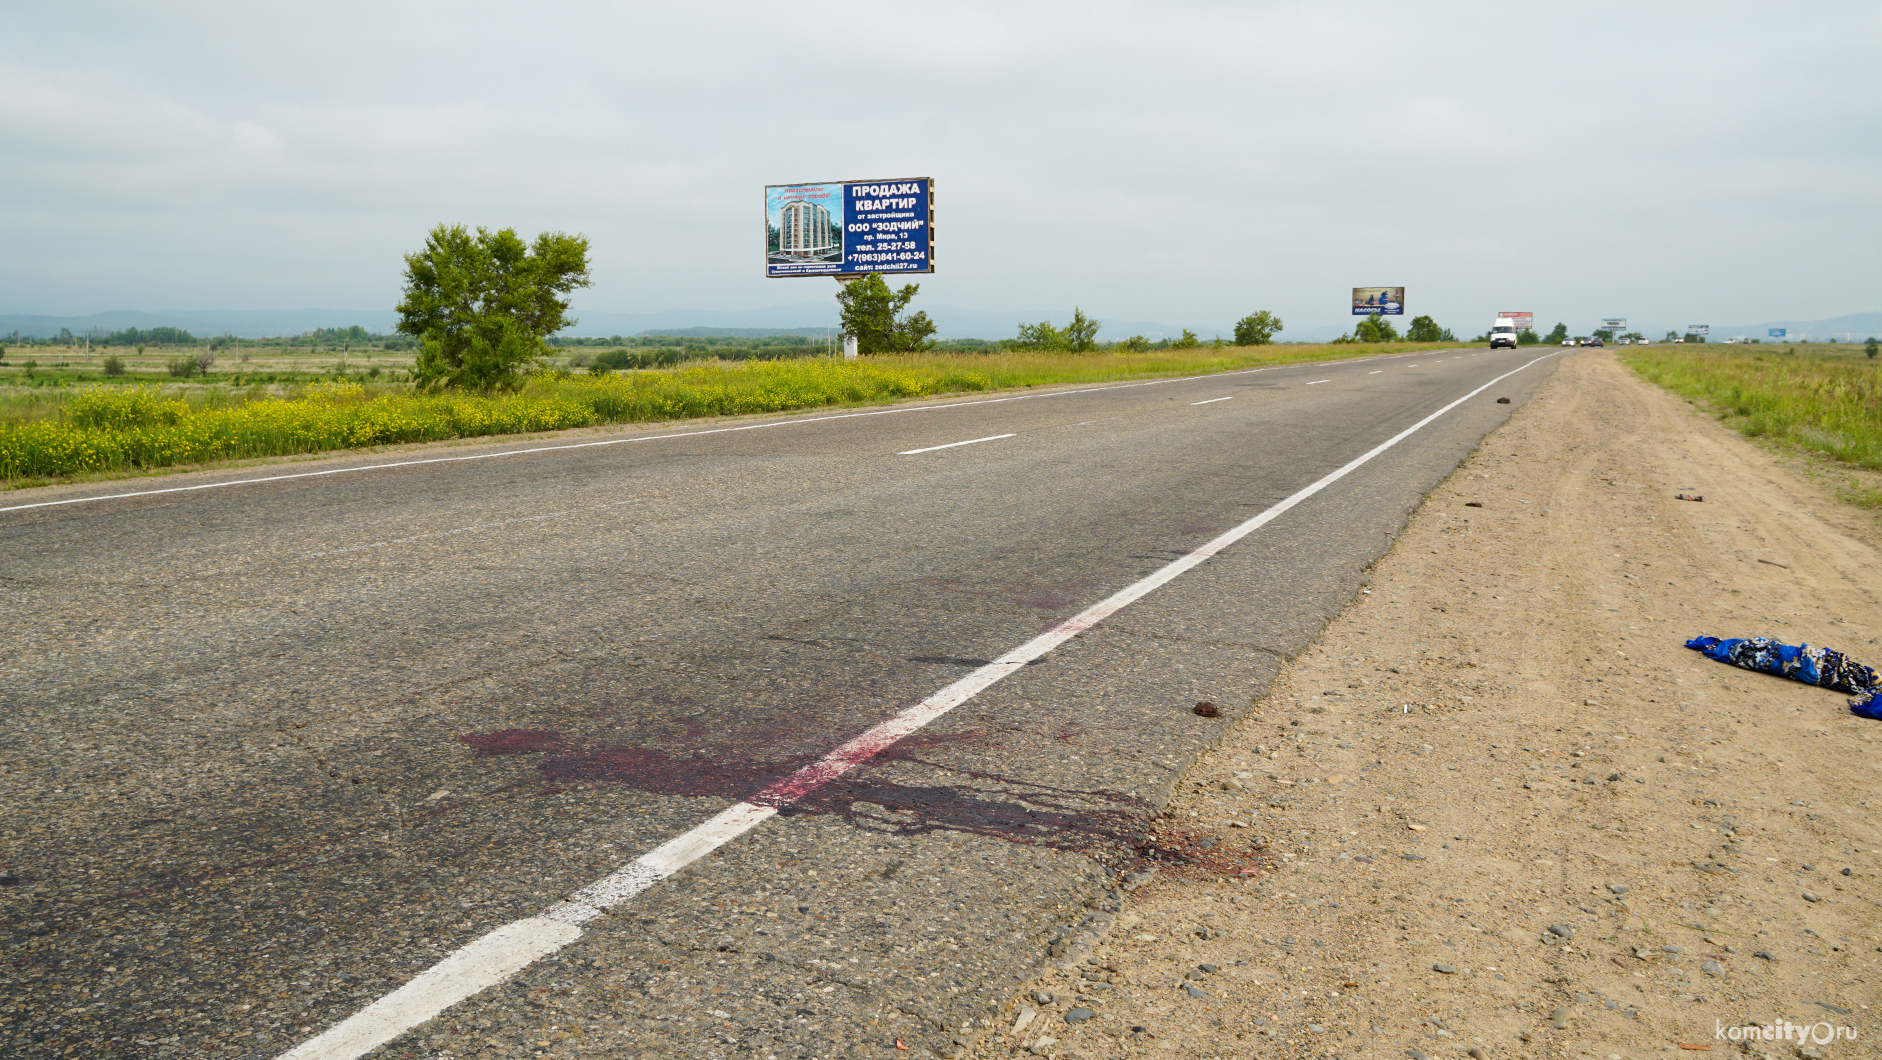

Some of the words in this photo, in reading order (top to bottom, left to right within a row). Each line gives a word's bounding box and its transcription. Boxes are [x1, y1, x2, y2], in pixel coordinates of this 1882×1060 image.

[852, 183, 920, 197] ПРОДАЖА
[856, 198, 917, 211] КВАРТИР
[867, 211, 914, 219] застройщика
[848, 223, 870, 232] ООО
[877, 242, 916, 250] 25-27-58
[847, 251, 925, 263] +7(963)841-60-24
